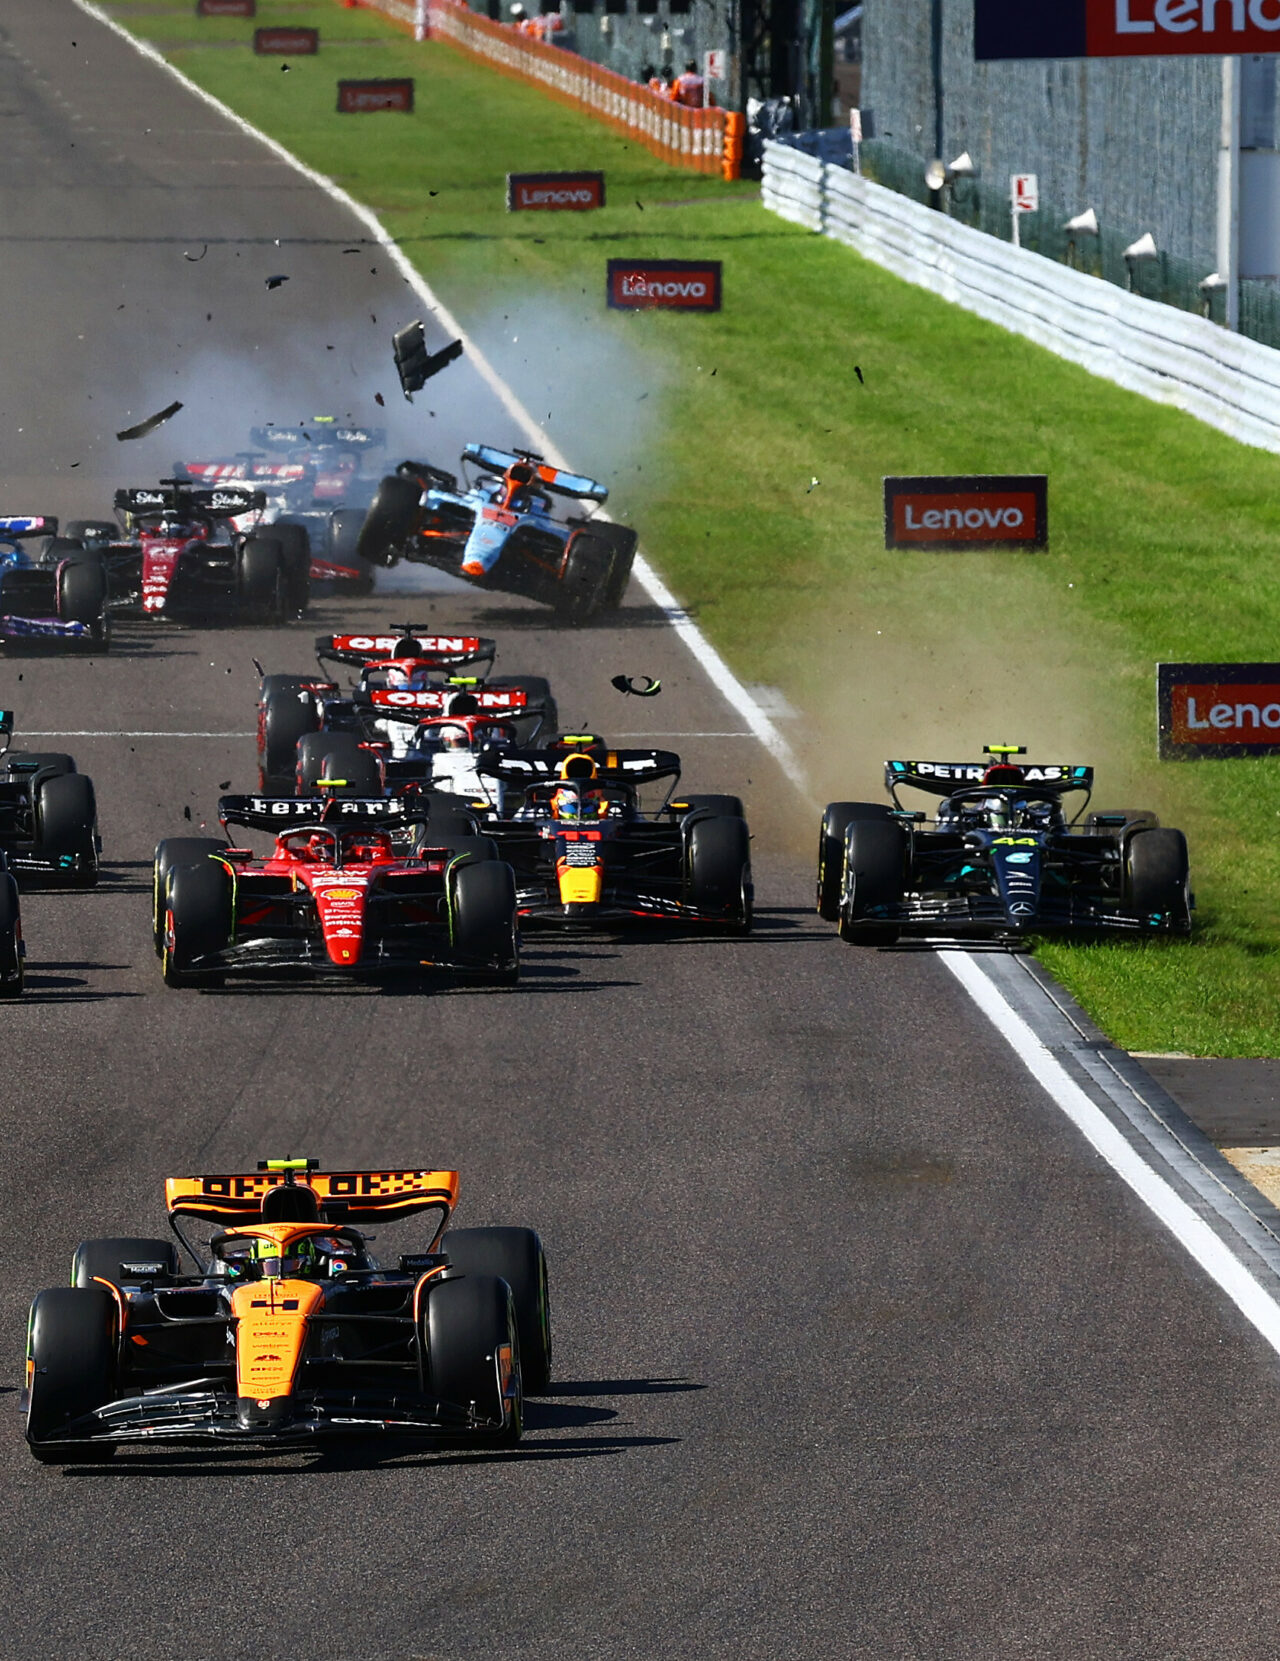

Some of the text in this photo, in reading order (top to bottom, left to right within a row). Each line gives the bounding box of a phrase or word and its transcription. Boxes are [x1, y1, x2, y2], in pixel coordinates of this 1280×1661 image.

[1115, 0, 1280, 34] Leno
[522, 188, 593, 204] Lenovo
[622, 278, 707, 297] Lenovo
[904, 504, 1024, 530] Lenovo
[348, 636, 464, 651] OREN
[386, 692, 511, 707] ORN
[1187, 697, 1280, 728] Leno
[917, 763, 1062, 781] PETRAS
[250, 798, 405, 815] Ferari
[556, 830, 603, 841] 11
[991, 837, 1039, 846] 44
